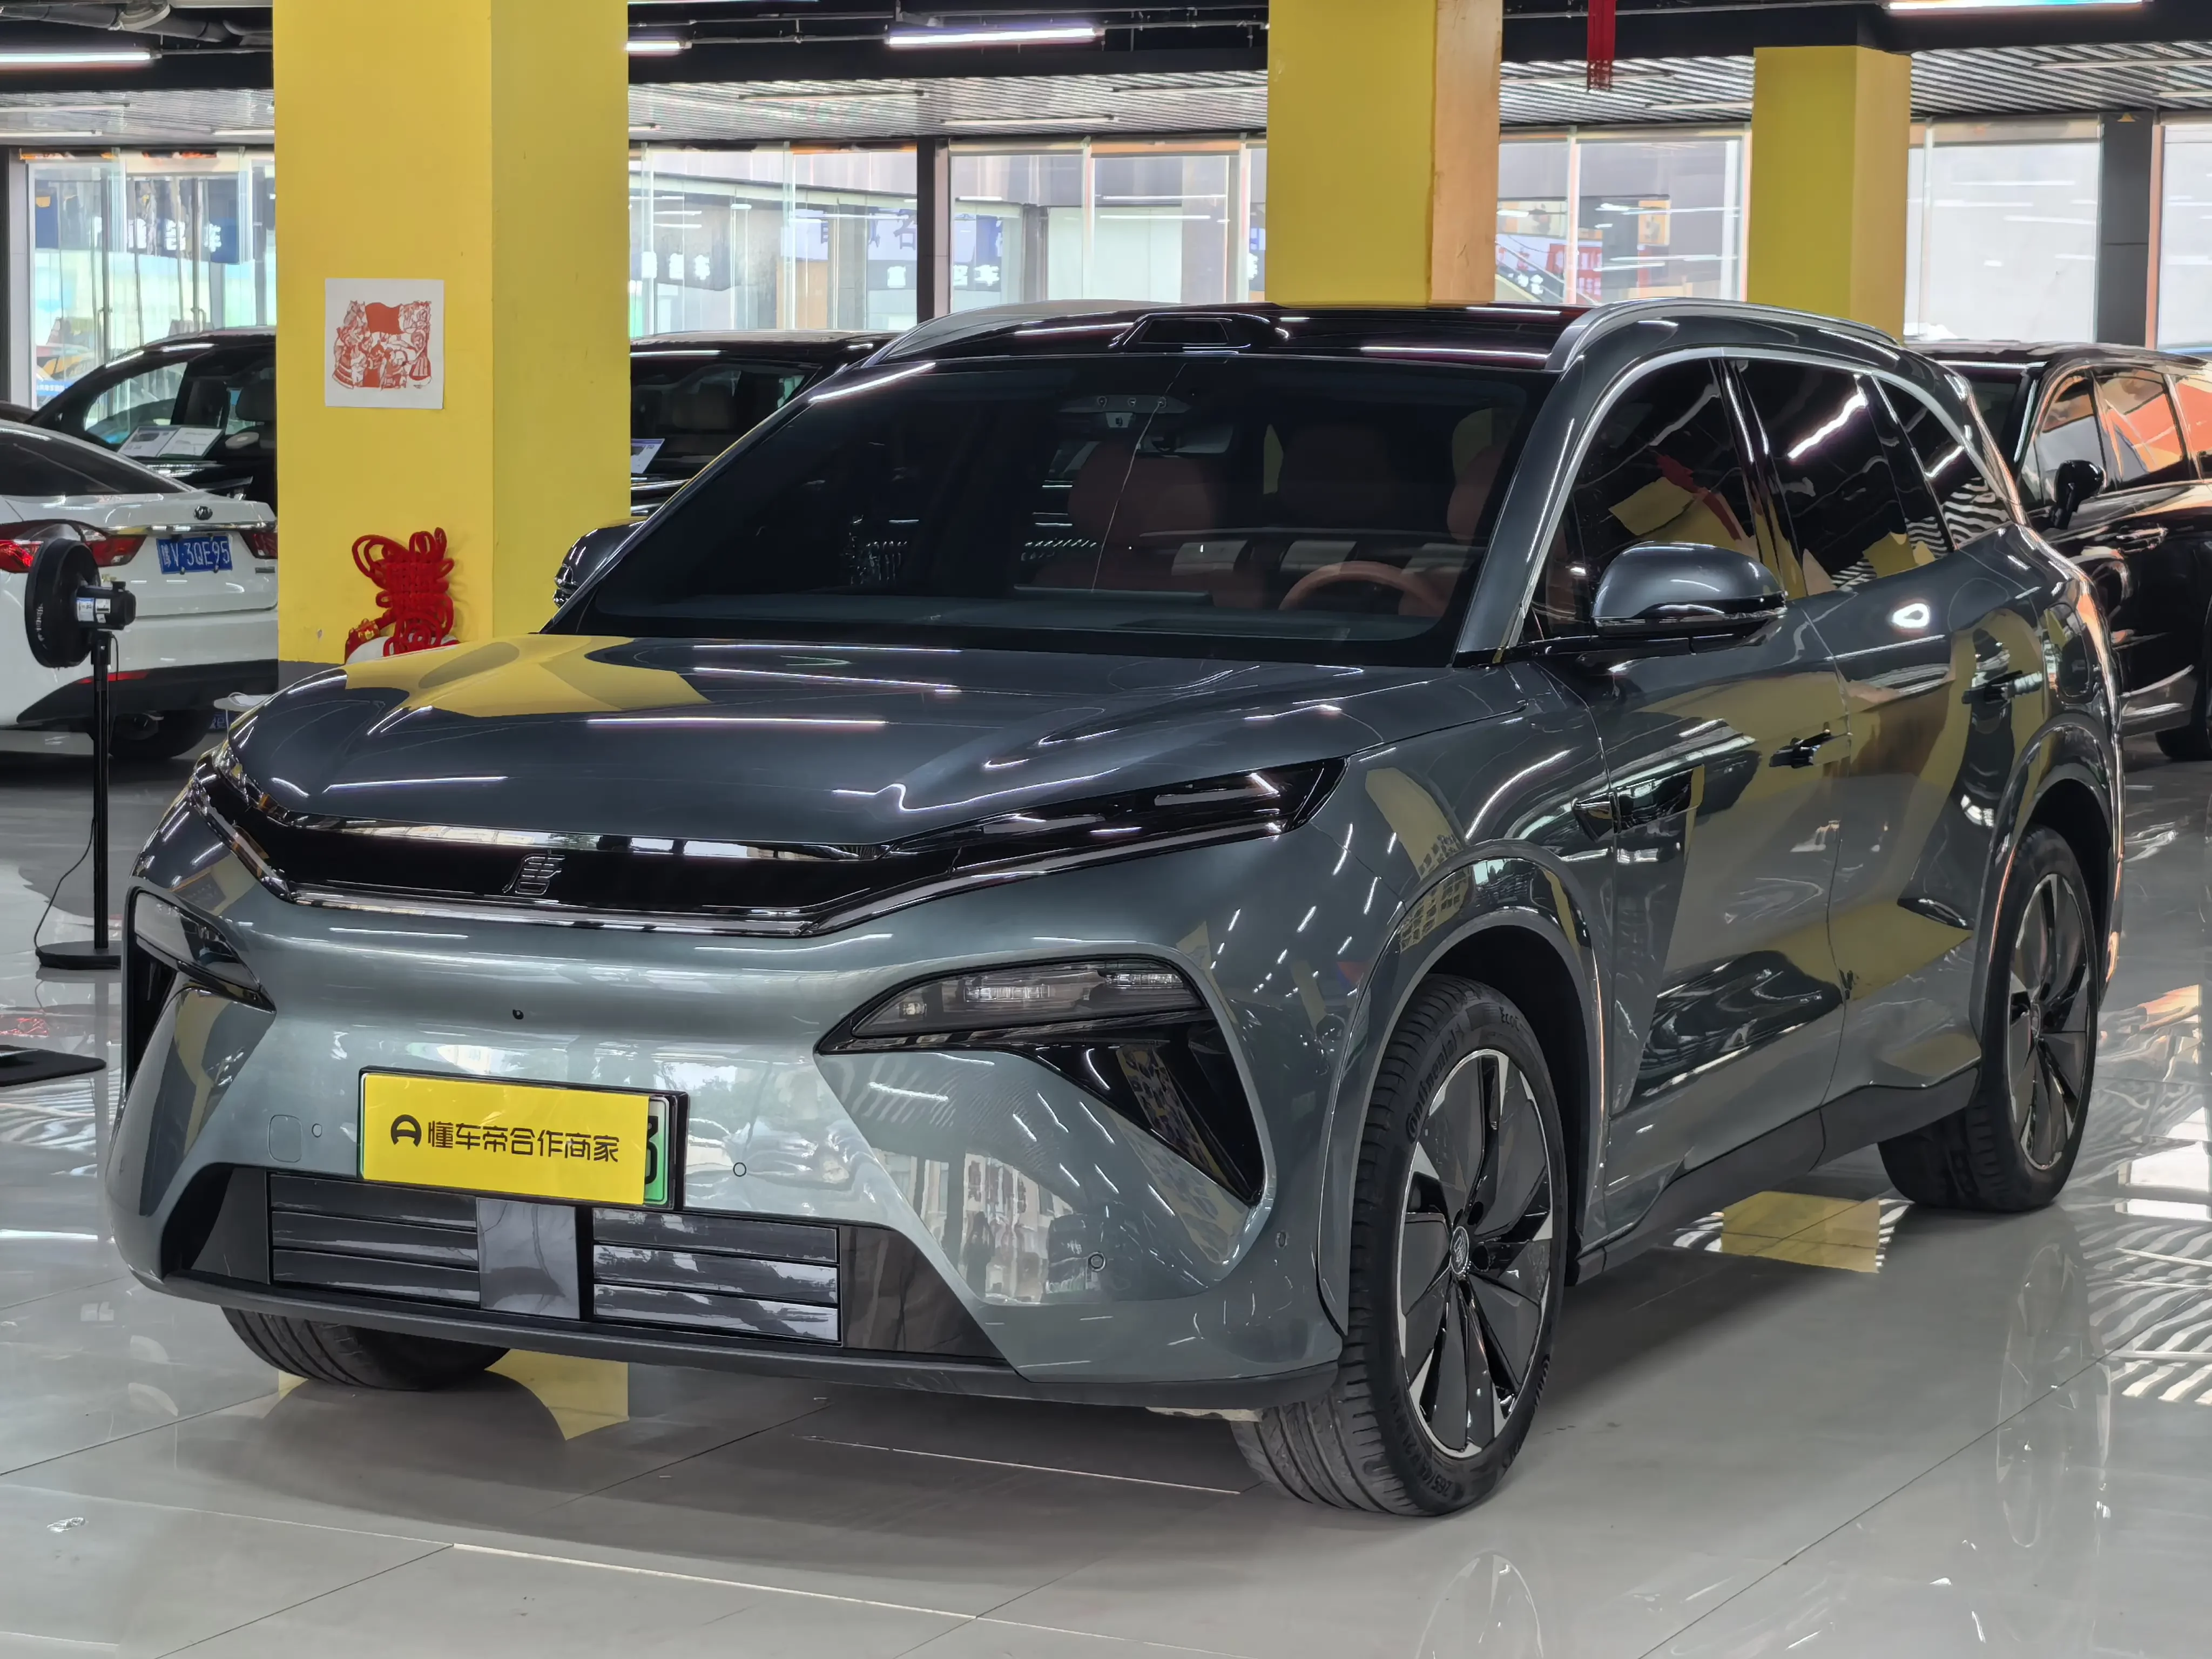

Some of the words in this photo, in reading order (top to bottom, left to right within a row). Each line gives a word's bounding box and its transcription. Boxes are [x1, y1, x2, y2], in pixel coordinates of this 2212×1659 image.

[428, 1120, 619, 1163] 懂车帝合作商家
